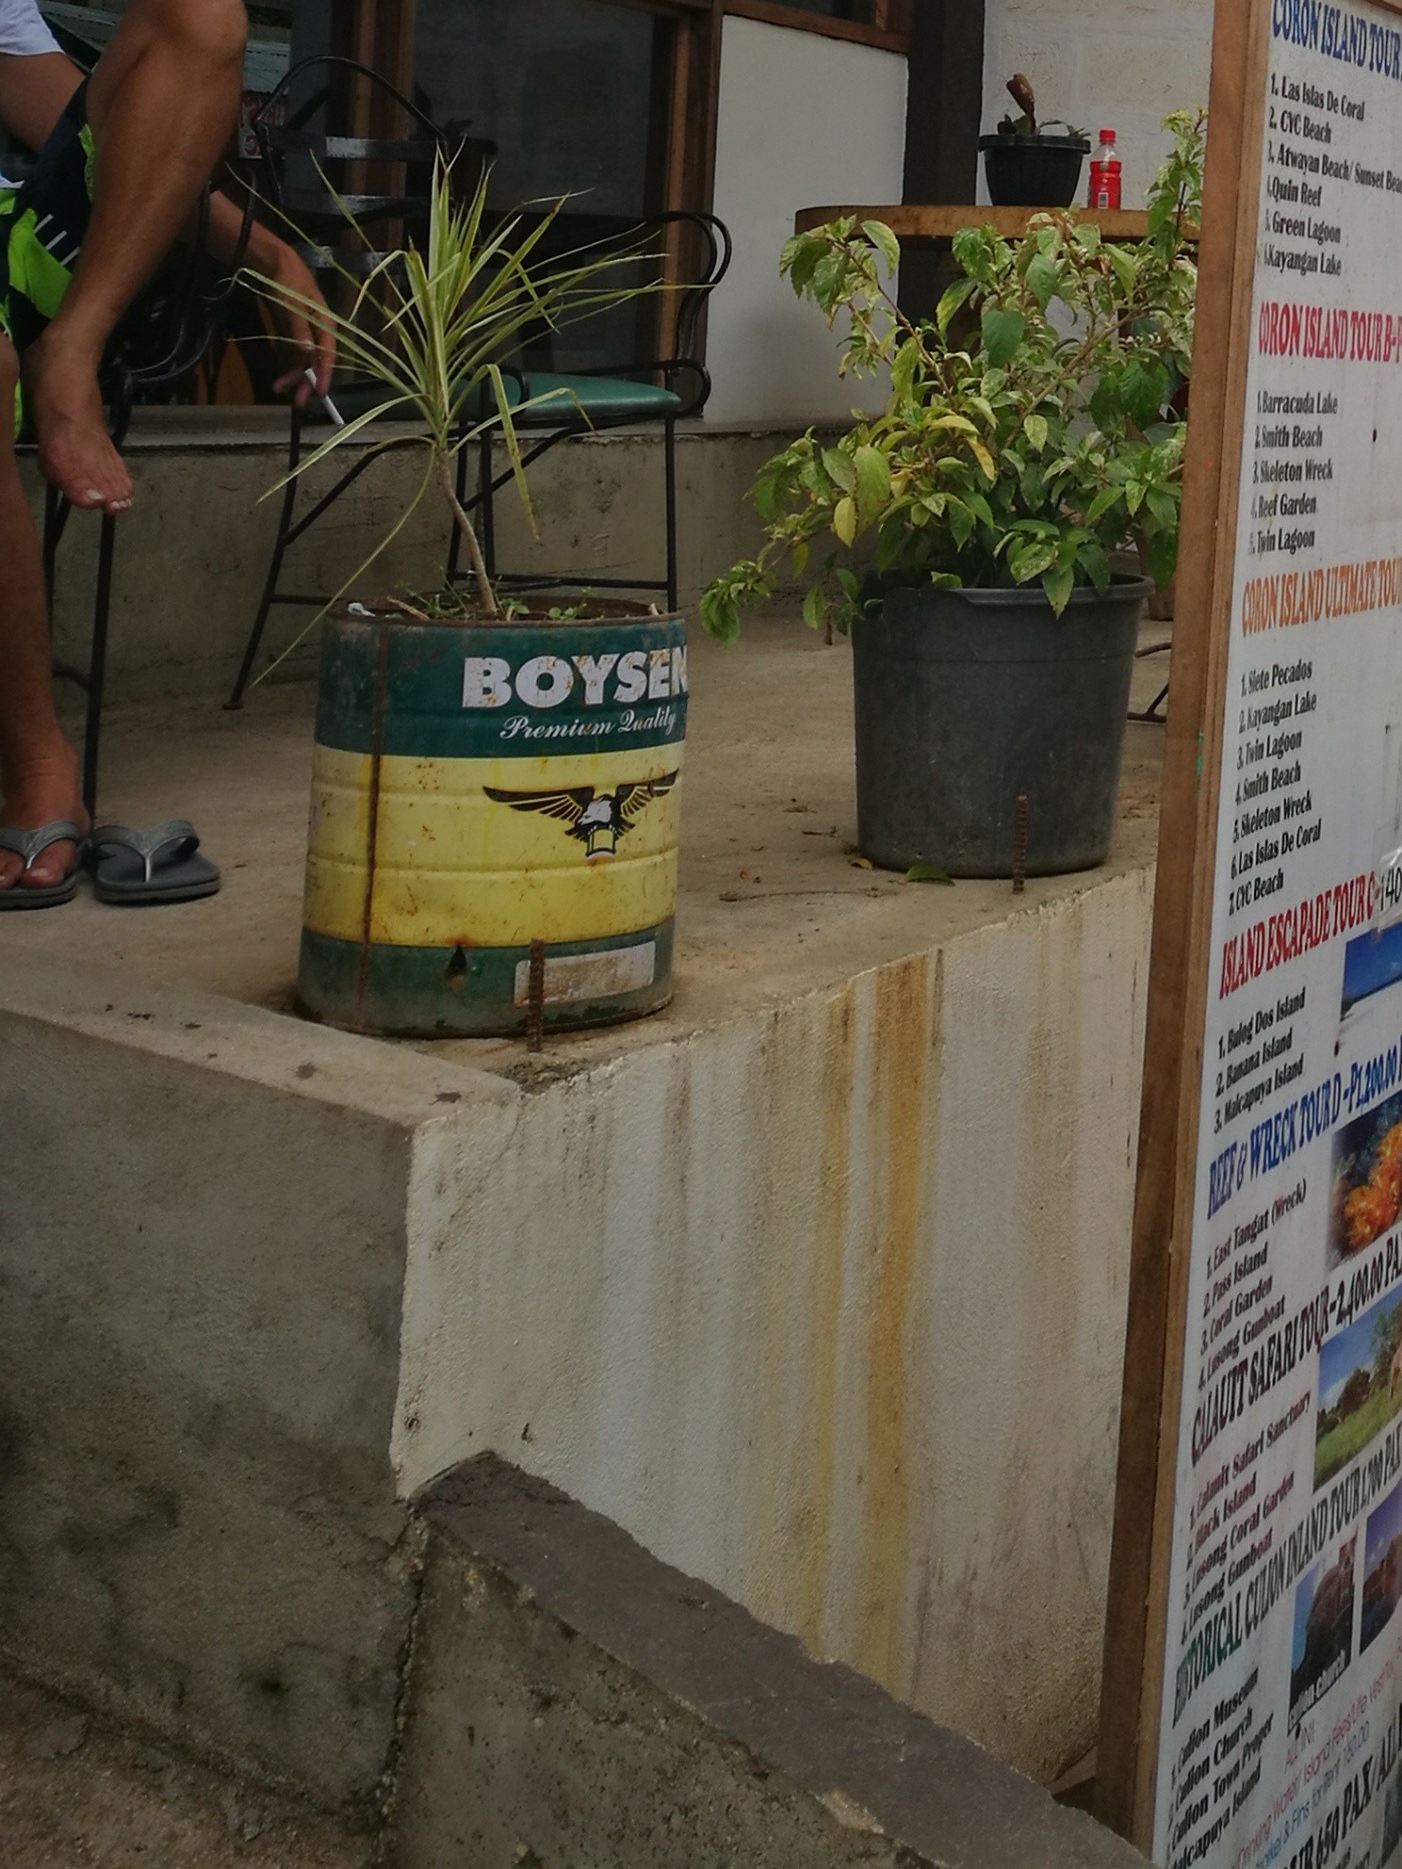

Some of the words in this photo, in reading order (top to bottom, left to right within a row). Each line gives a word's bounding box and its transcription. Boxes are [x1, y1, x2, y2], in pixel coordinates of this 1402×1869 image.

[1321, 3, 1367, 69] ISLAND
[1367, 22, 1402, 82] TOUR
[1281, 75, 1301, 103] Las
[1302, 82, 1324, 110] Islas
[1340, 95, 1364, 122] Coral
[1280, 109, 1302, 137] CYC
[1303, 115, 1331, 144] Beach
[1276, 142, 1319, 180] Atwayan
[1354, 162, 1384, 190] Sunset
[1271, 210, 1305, 238] Green
[1306, 217, 1341, 248] Lagoon
[1320, 252, 1341, 276] Lake
[1302, 304, 1348, 360] ISLAND
[1348, 309, 1383, 363] TOUR
[1316, 391, 1338, 415] Lake
[1291, 425, 1323, 448] Beach
[1304, 458, 1333, 482] Wreck
[1279, 492, 1316, 517] Garden
[1277, 526, 1315, 556] Lagoon
[1240, 575, 1279, 637] CORON
[1279, 568, 1324, 629] ISLAND
[1324, 560, 1376, 619] ULTIMATE
[462, 645, 688, 708] BOYSEN
[1271, 657, 1312, 689] Pecados
[1294, 689, 1317, 716] Lake
[500, 715, 615, 740] Premium
[618, 710, 676, 735] Quality
[1265, 726, 1302, 763] Lagoon
[1271, 759, 1301, 792] Beach
[1282, 787, 1312, 821] Wreck
[1295, 817, 1321, 849] Coral
[1253, 866, 1283, 901] Beach
[1219, 921, 1264, 1001] ISLAND
[1265, 889, 1330, 972] ESCAPADE
[1331, 872, 1366, 938] TOUR
[1275, 986, 1305, 1024] Island
[1262, 1027, 1292, 1066] Island
[1274, 1053, 1303, 1092] Island
[1247, 1099, 1298, 1185] WRECK
[1233, 1241, 1267, 1289] Island
[1247, 1313, 1298, 1410] SAFARI
[1327, 1459, 1361, 1548] TOUR
